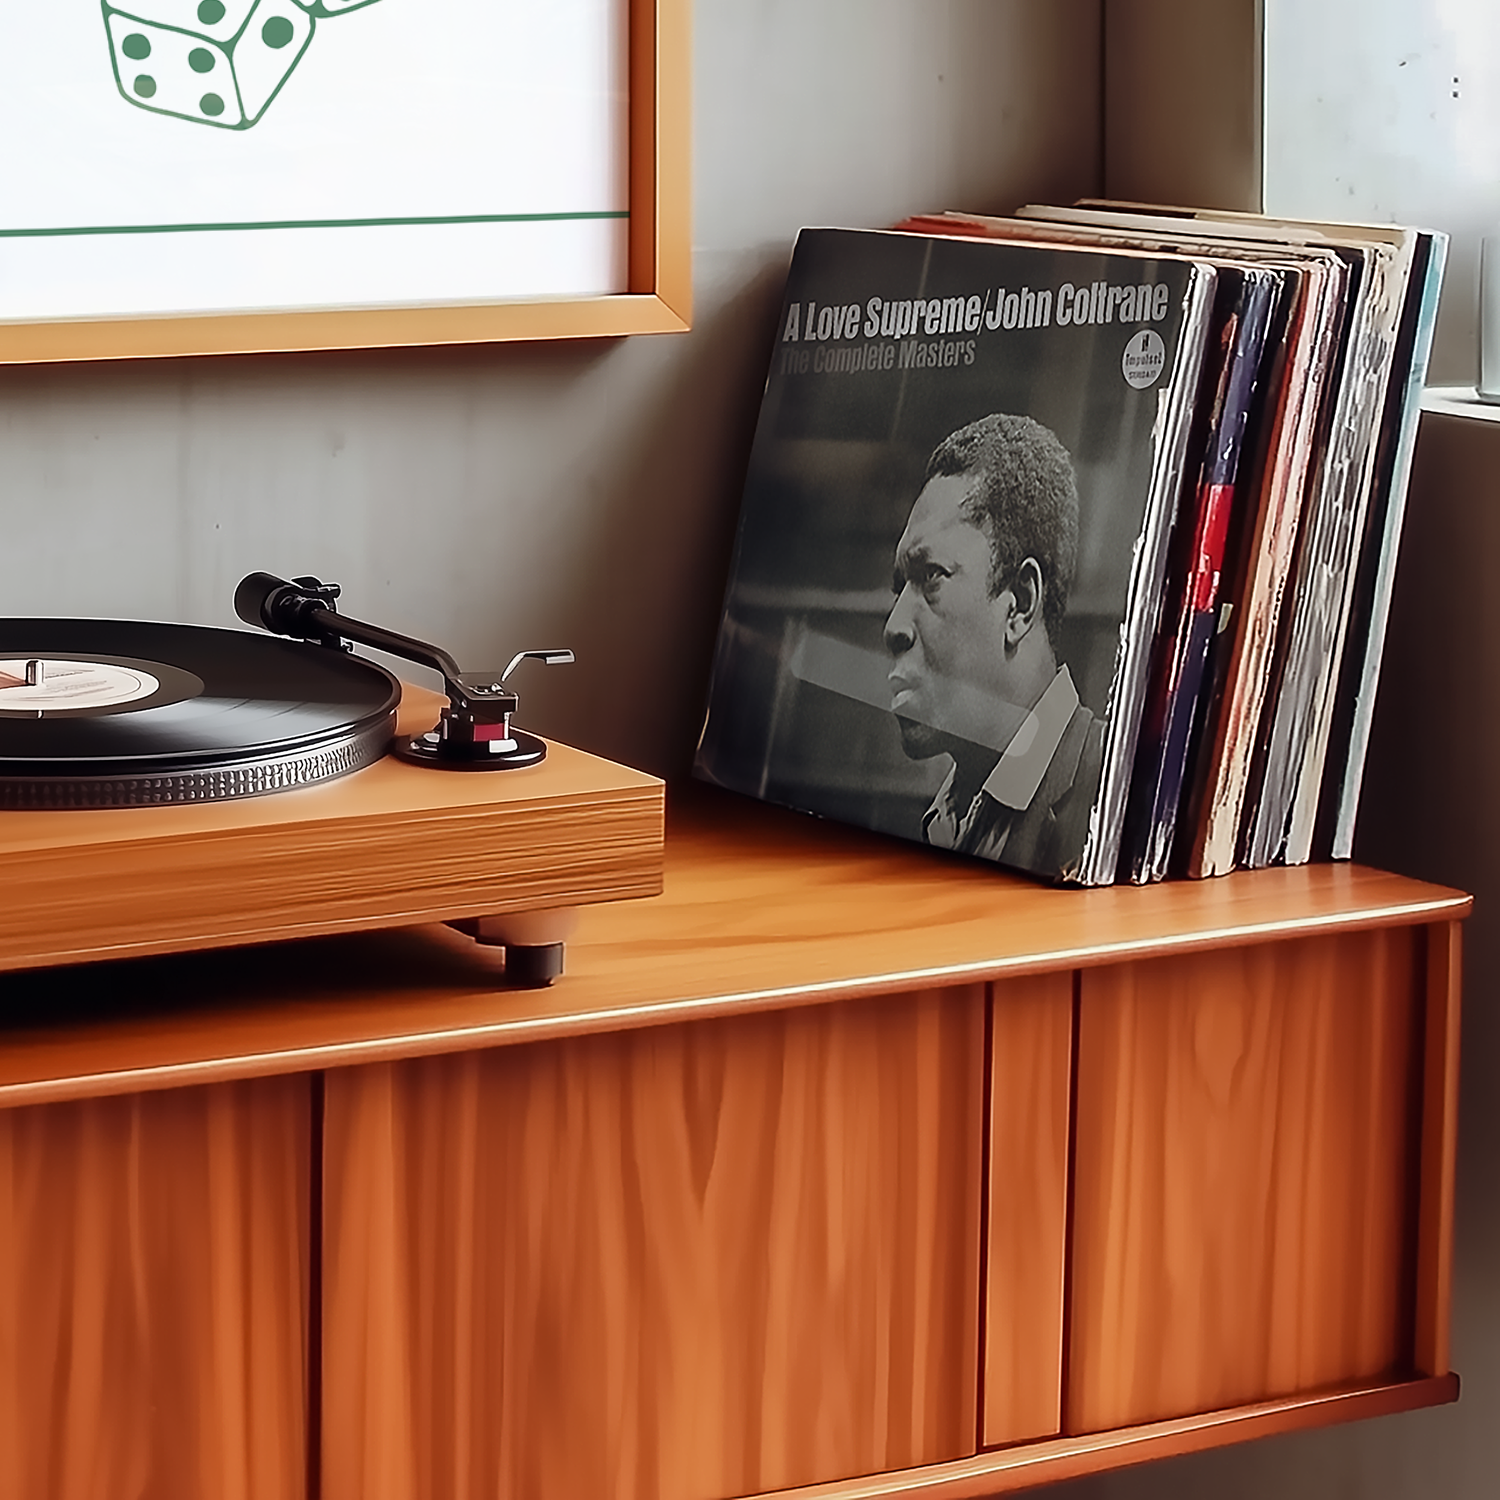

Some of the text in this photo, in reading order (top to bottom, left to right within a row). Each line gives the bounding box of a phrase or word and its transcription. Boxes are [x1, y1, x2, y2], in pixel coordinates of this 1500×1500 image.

[782, 303, 800, 342] A
[804, 302, 861, 341] Love
[1056, 282, 1169, 327] Coltrane
[780, 338, 976, 375] The Complete Masters
